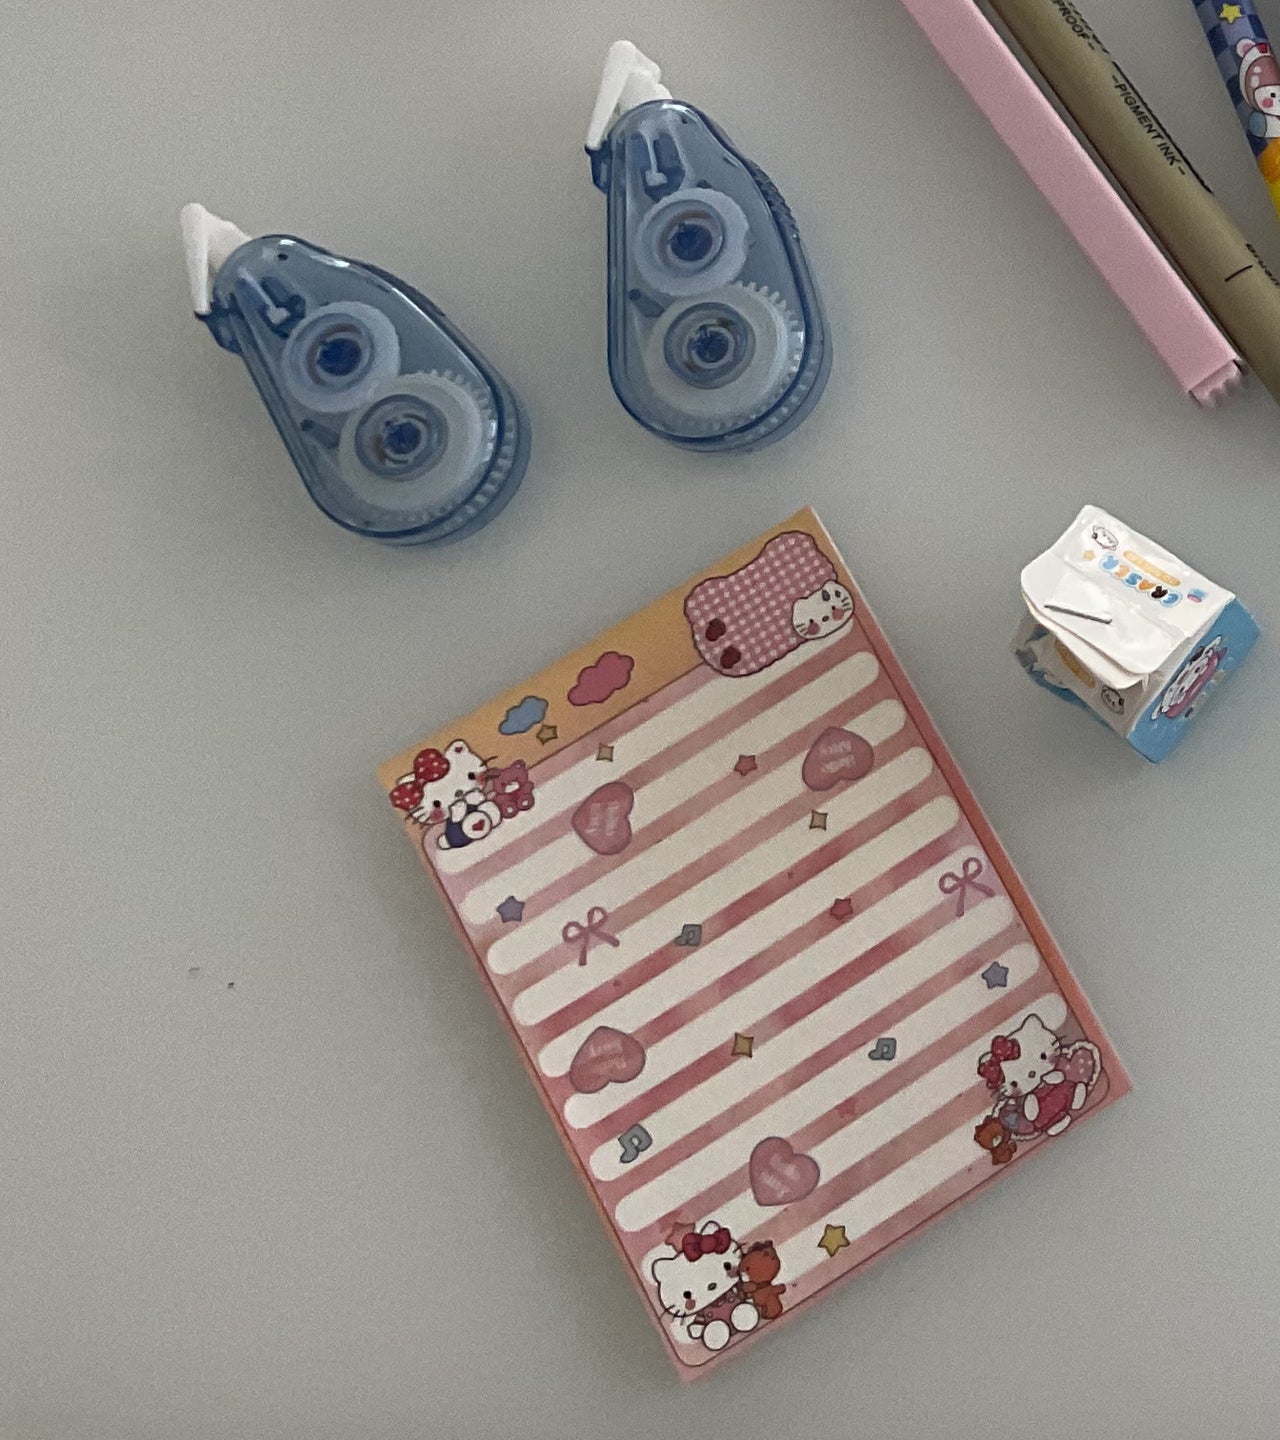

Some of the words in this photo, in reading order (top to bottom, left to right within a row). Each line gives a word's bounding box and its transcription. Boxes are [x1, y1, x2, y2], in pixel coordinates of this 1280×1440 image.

[1113, 80, 1162, 140] PIGMENT
[1158, 140, 1182, 168] INK
[1100, 554, 1182, 607] ERASER
